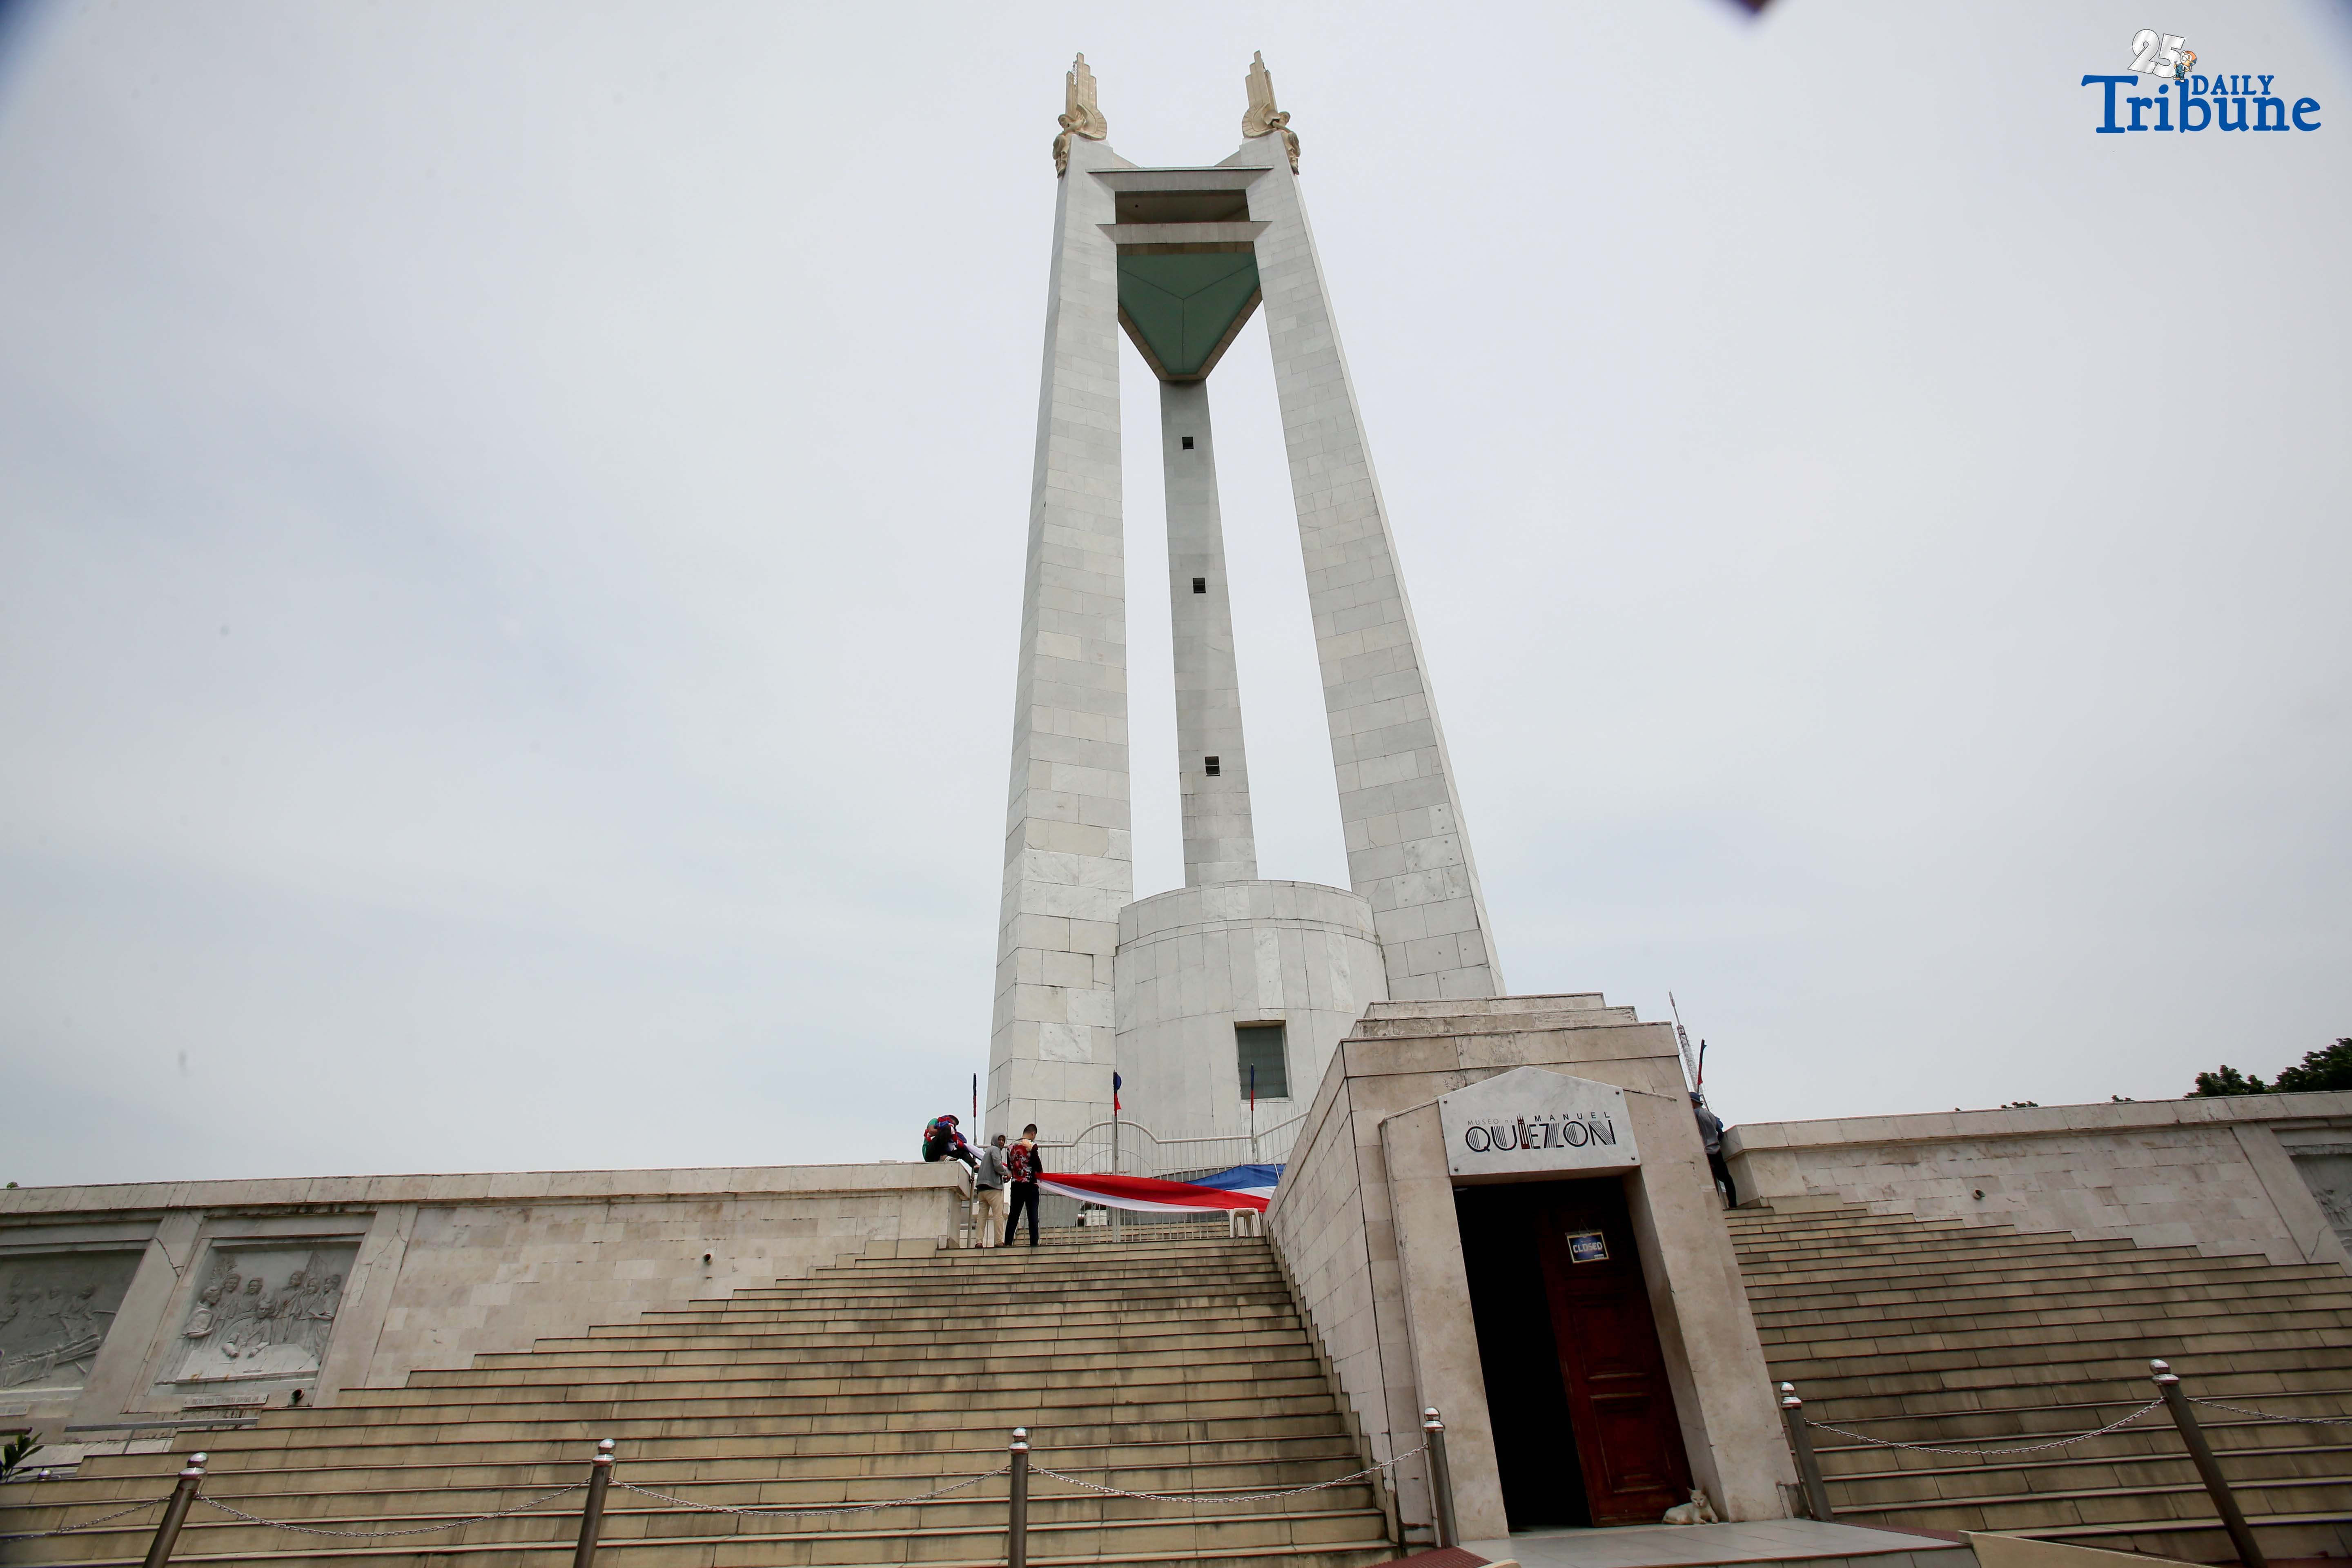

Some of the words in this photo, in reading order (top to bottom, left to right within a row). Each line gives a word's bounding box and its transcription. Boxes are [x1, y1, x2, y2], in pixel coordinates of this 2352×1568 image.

[1534, 1111, 1610, 1122] MANUEL
[1465, 1120, 1616, 1153] QUEZON
[1572, 1242, 1603, 1253] CLOSED
